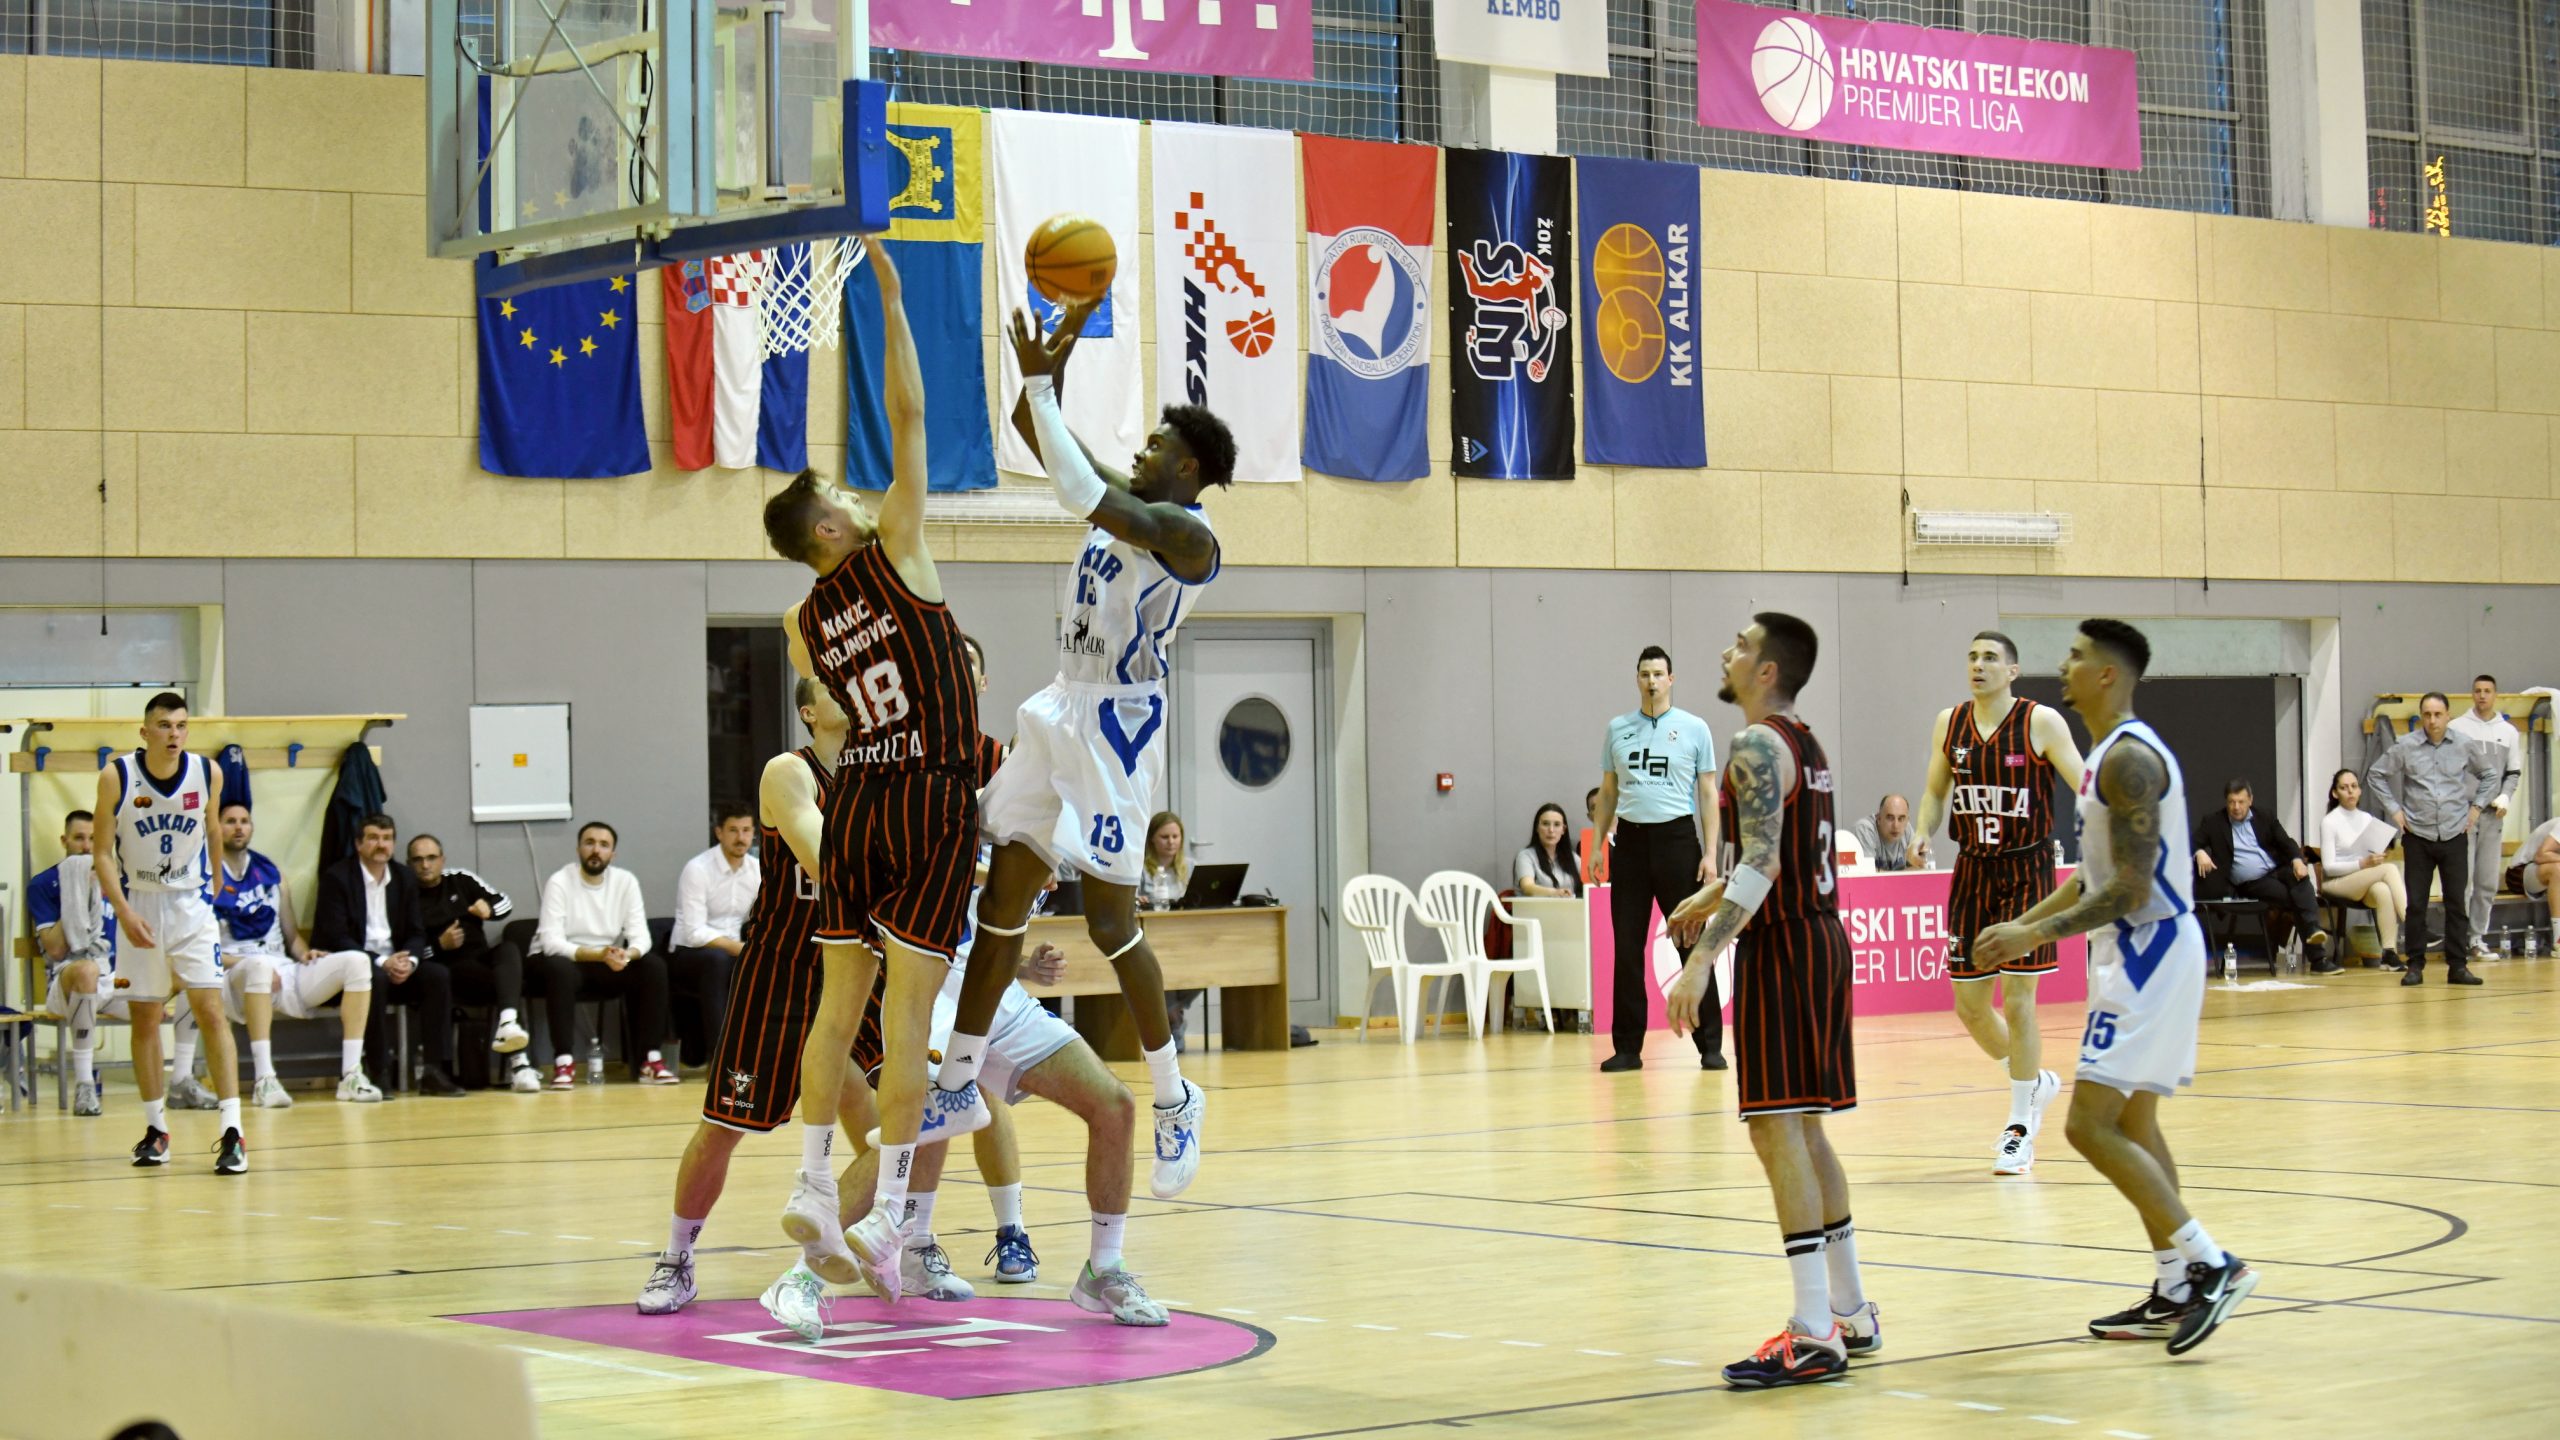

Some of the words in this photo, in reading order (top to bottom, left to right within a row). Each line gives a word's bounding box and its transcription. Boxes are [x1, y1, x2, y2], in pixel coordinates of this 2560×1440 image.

[1487, 0, 1561, 21] KEMBO
[1840, 46, 1969, 91] HRVATSKI
[1974, 61, 2089, 103] TELEKOM
[1843, 84, 1962, 128] PREMIJER
[1969, 97, 2024, 134] LIGA
[1537, 217, 1554, 256] ŽOK
[1667, 222, 1690, 332] ALKAR
[1183, 275, 1208, 407] HKS
[1669, 340, 1693, 387] KK
[1076, 573, 1098, 606] 13
[821, 593, 871, 641] NAKIĆ
[820, 608, 898, 671] VOJNOVIĆ
[846, 659, 910, 733] 18
[134, 813, 198, 838] ALKAR
[160, 833, 173, 855] 8
[1090, 812, 1125, 854] 13
[1975, 816, 2001, 845] 12
[2082, 1010, 2119, 1051] 15
[734, 1099, 755, 1109] alpas
[897, 1150, 911, 1179] alpas
